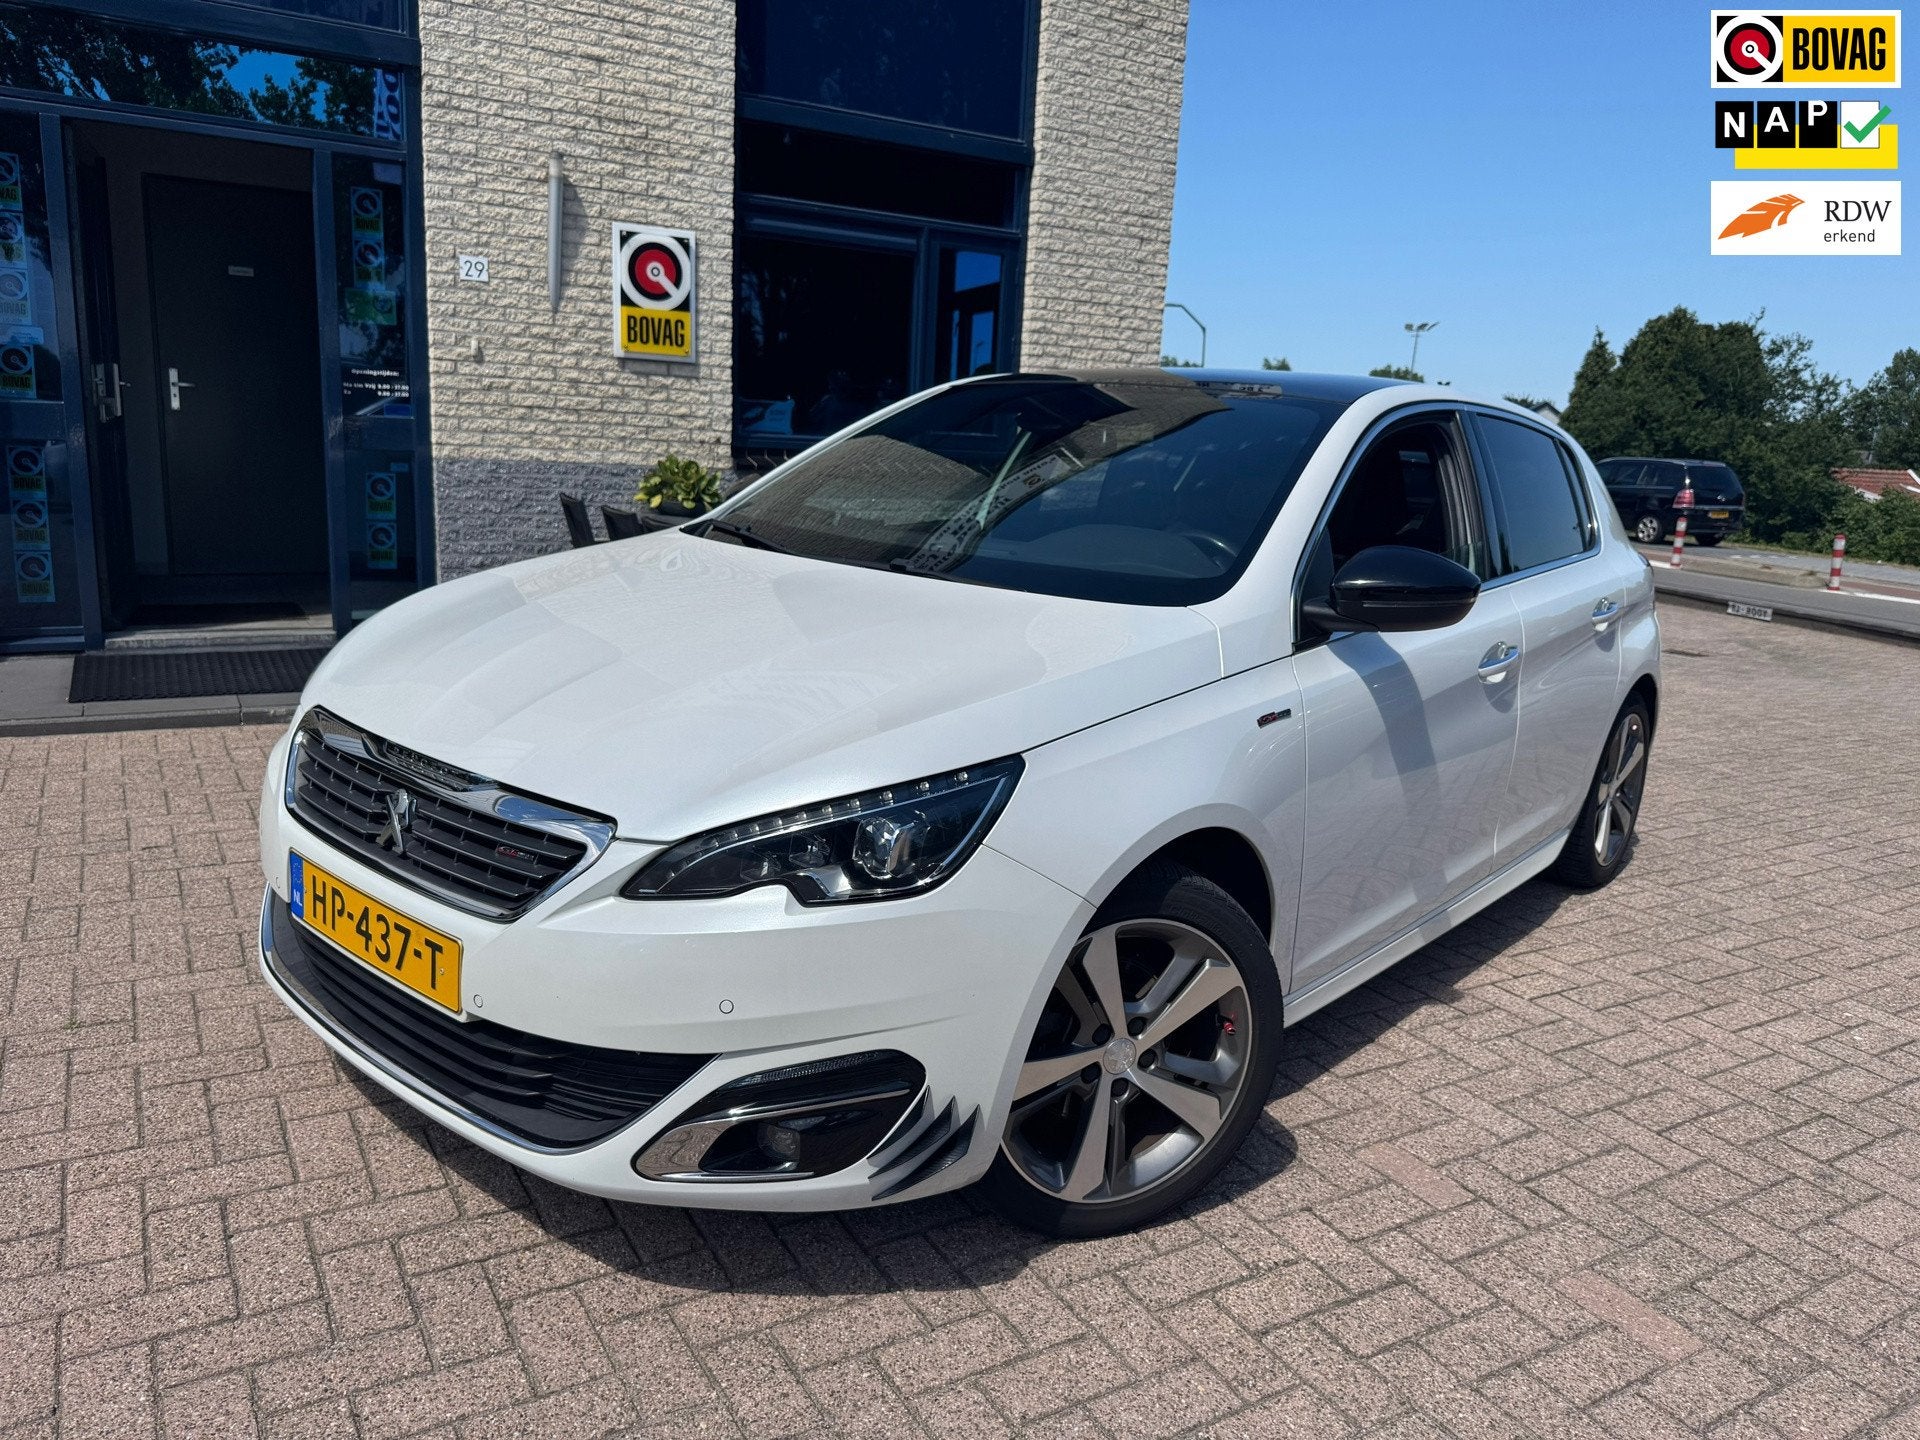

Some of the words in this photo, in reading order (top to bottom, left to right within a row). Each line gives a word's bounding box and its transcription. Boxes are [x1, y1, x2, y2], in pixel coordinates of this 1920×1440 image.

[463, 260, 486, 279] 29
[626, 314, 686, 348] BOVAG
[2, 374, 31, 390] BOVAG
[13, 477, 42, 490] BOVAG
[16, 529, 46, 543] BOVAG
[293, 889, 303, 906] NL
[312, 874, 444, 990] HP-437-T
